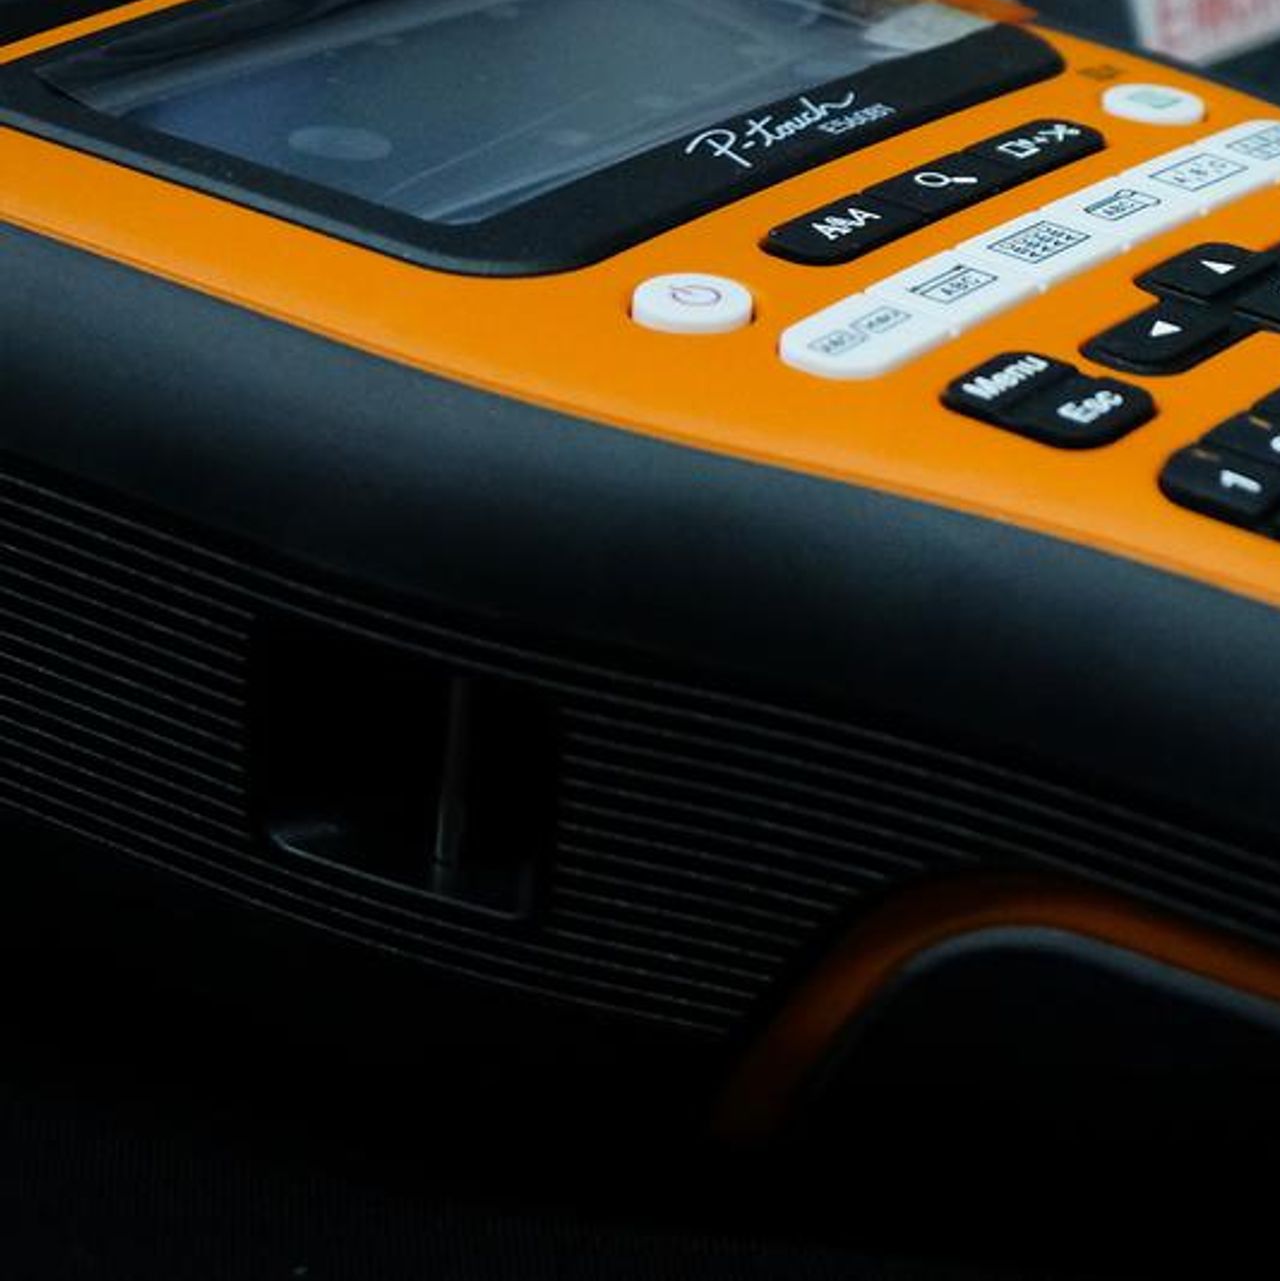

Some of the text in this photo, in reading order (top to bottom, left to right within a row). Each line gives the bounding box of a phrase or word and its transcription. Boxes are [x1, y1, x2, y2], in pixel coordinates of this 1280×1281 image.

[685, 90, 855, 169] P-touch
[961, 353, 1050, 402] Menu
[1056, 388, 1125, 425] Esc
[1219, 469, 1262, 493] 1
